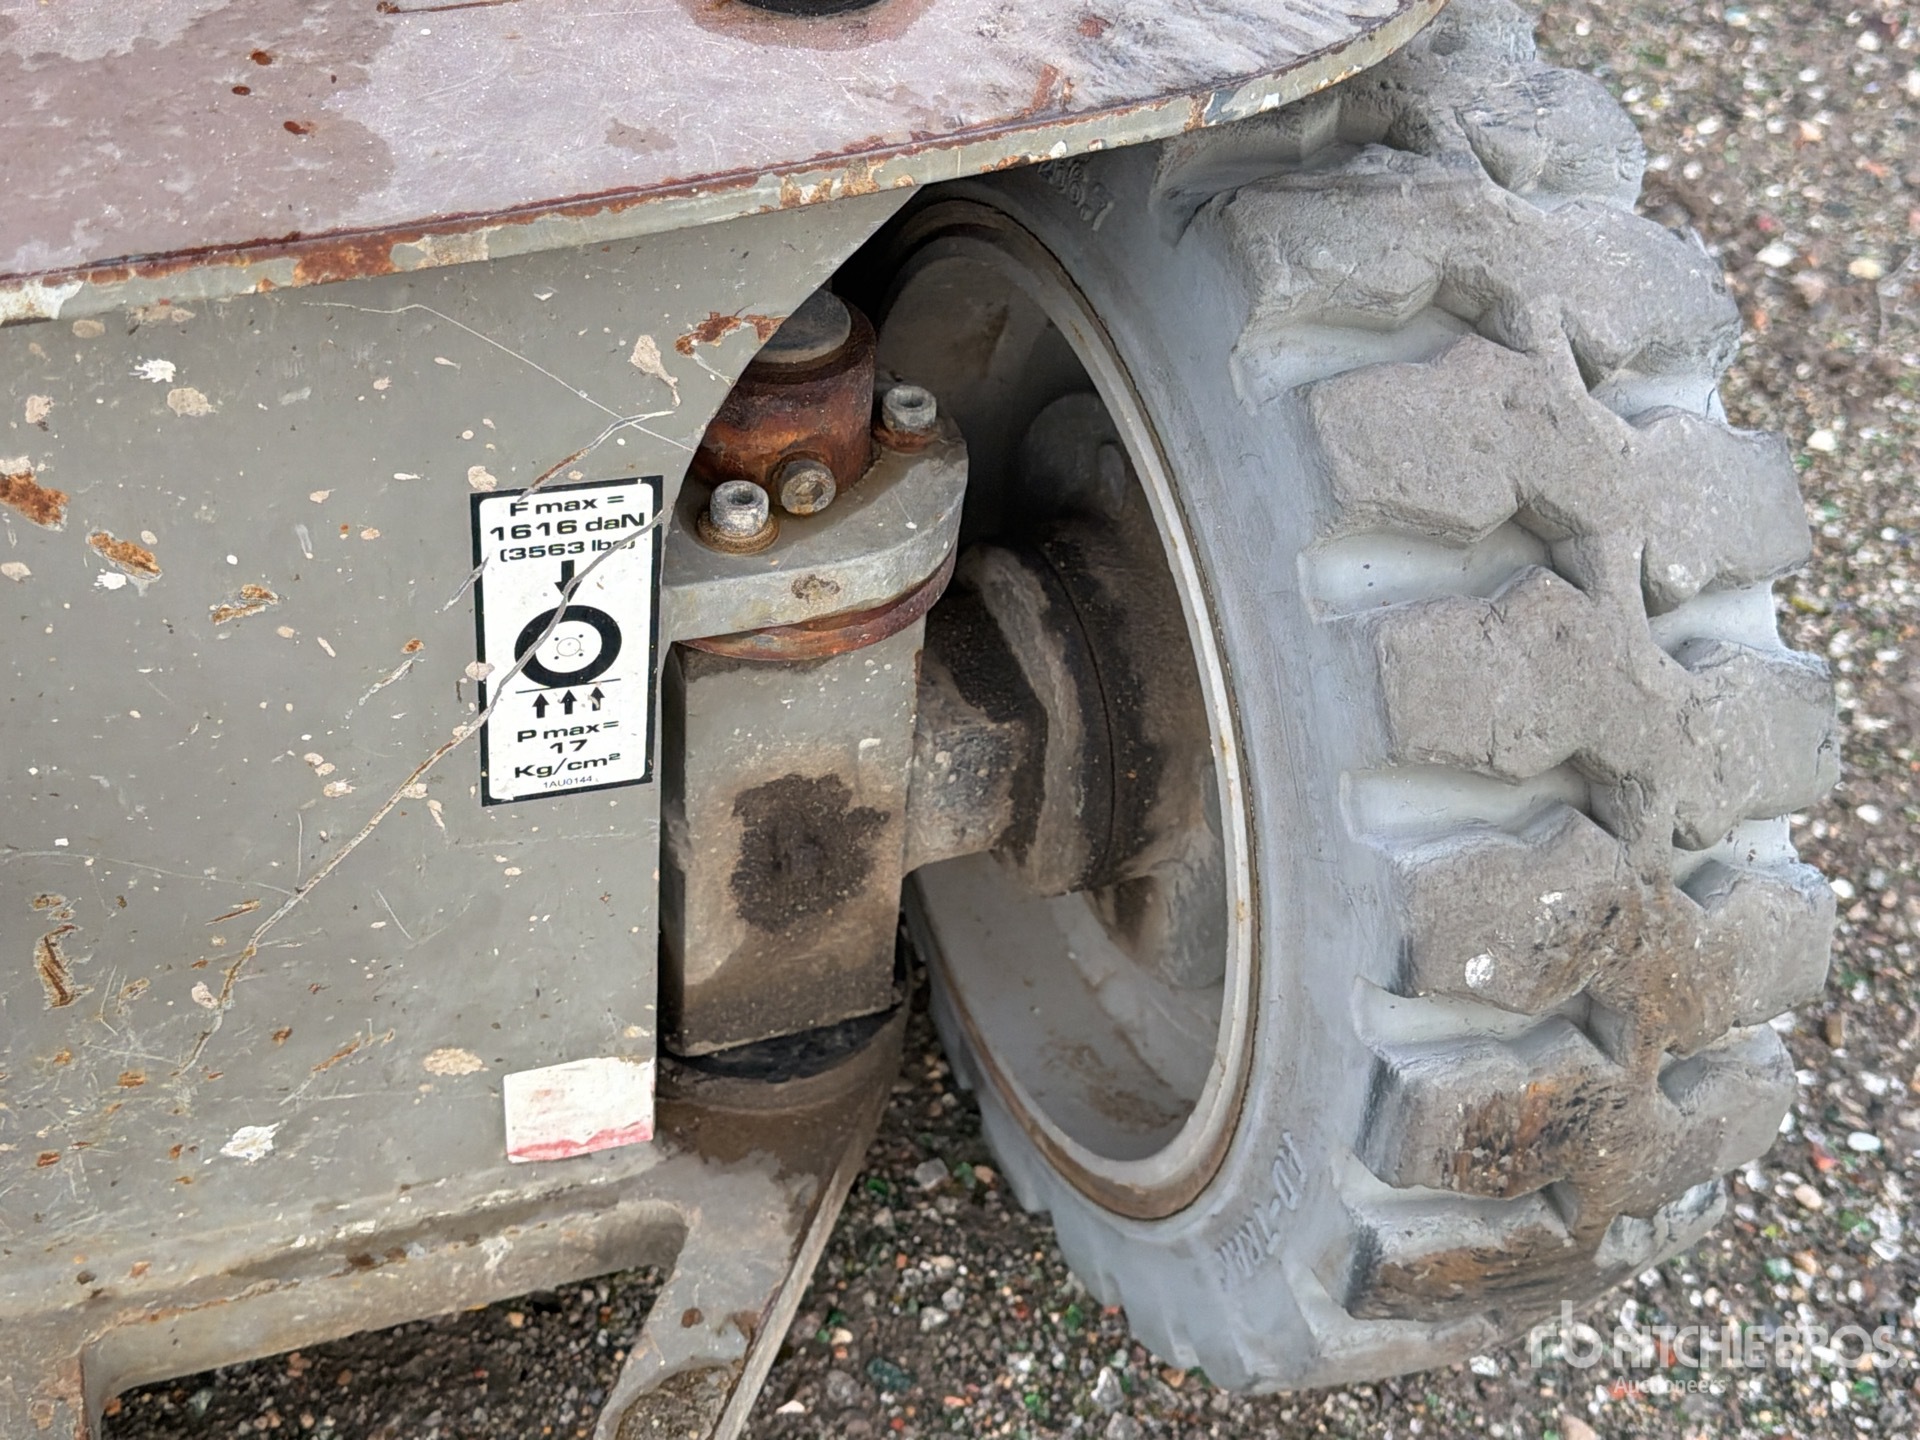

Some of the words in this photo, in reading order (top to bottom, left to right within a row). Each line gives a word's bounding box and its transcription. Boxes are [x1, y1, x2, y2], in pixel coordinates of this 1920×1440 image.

[510, 501, 528, 516] F
[535, 498, 598, 514] max
[489, 519, 578, 541] 1616
[585, 512, 645, 532] daN
[500, 540, 585, 562] (3563
[517, 729, 537, 743] P
[549, 738, 588, 754] 17
[543, 774, 593, 789] 1AU0144
